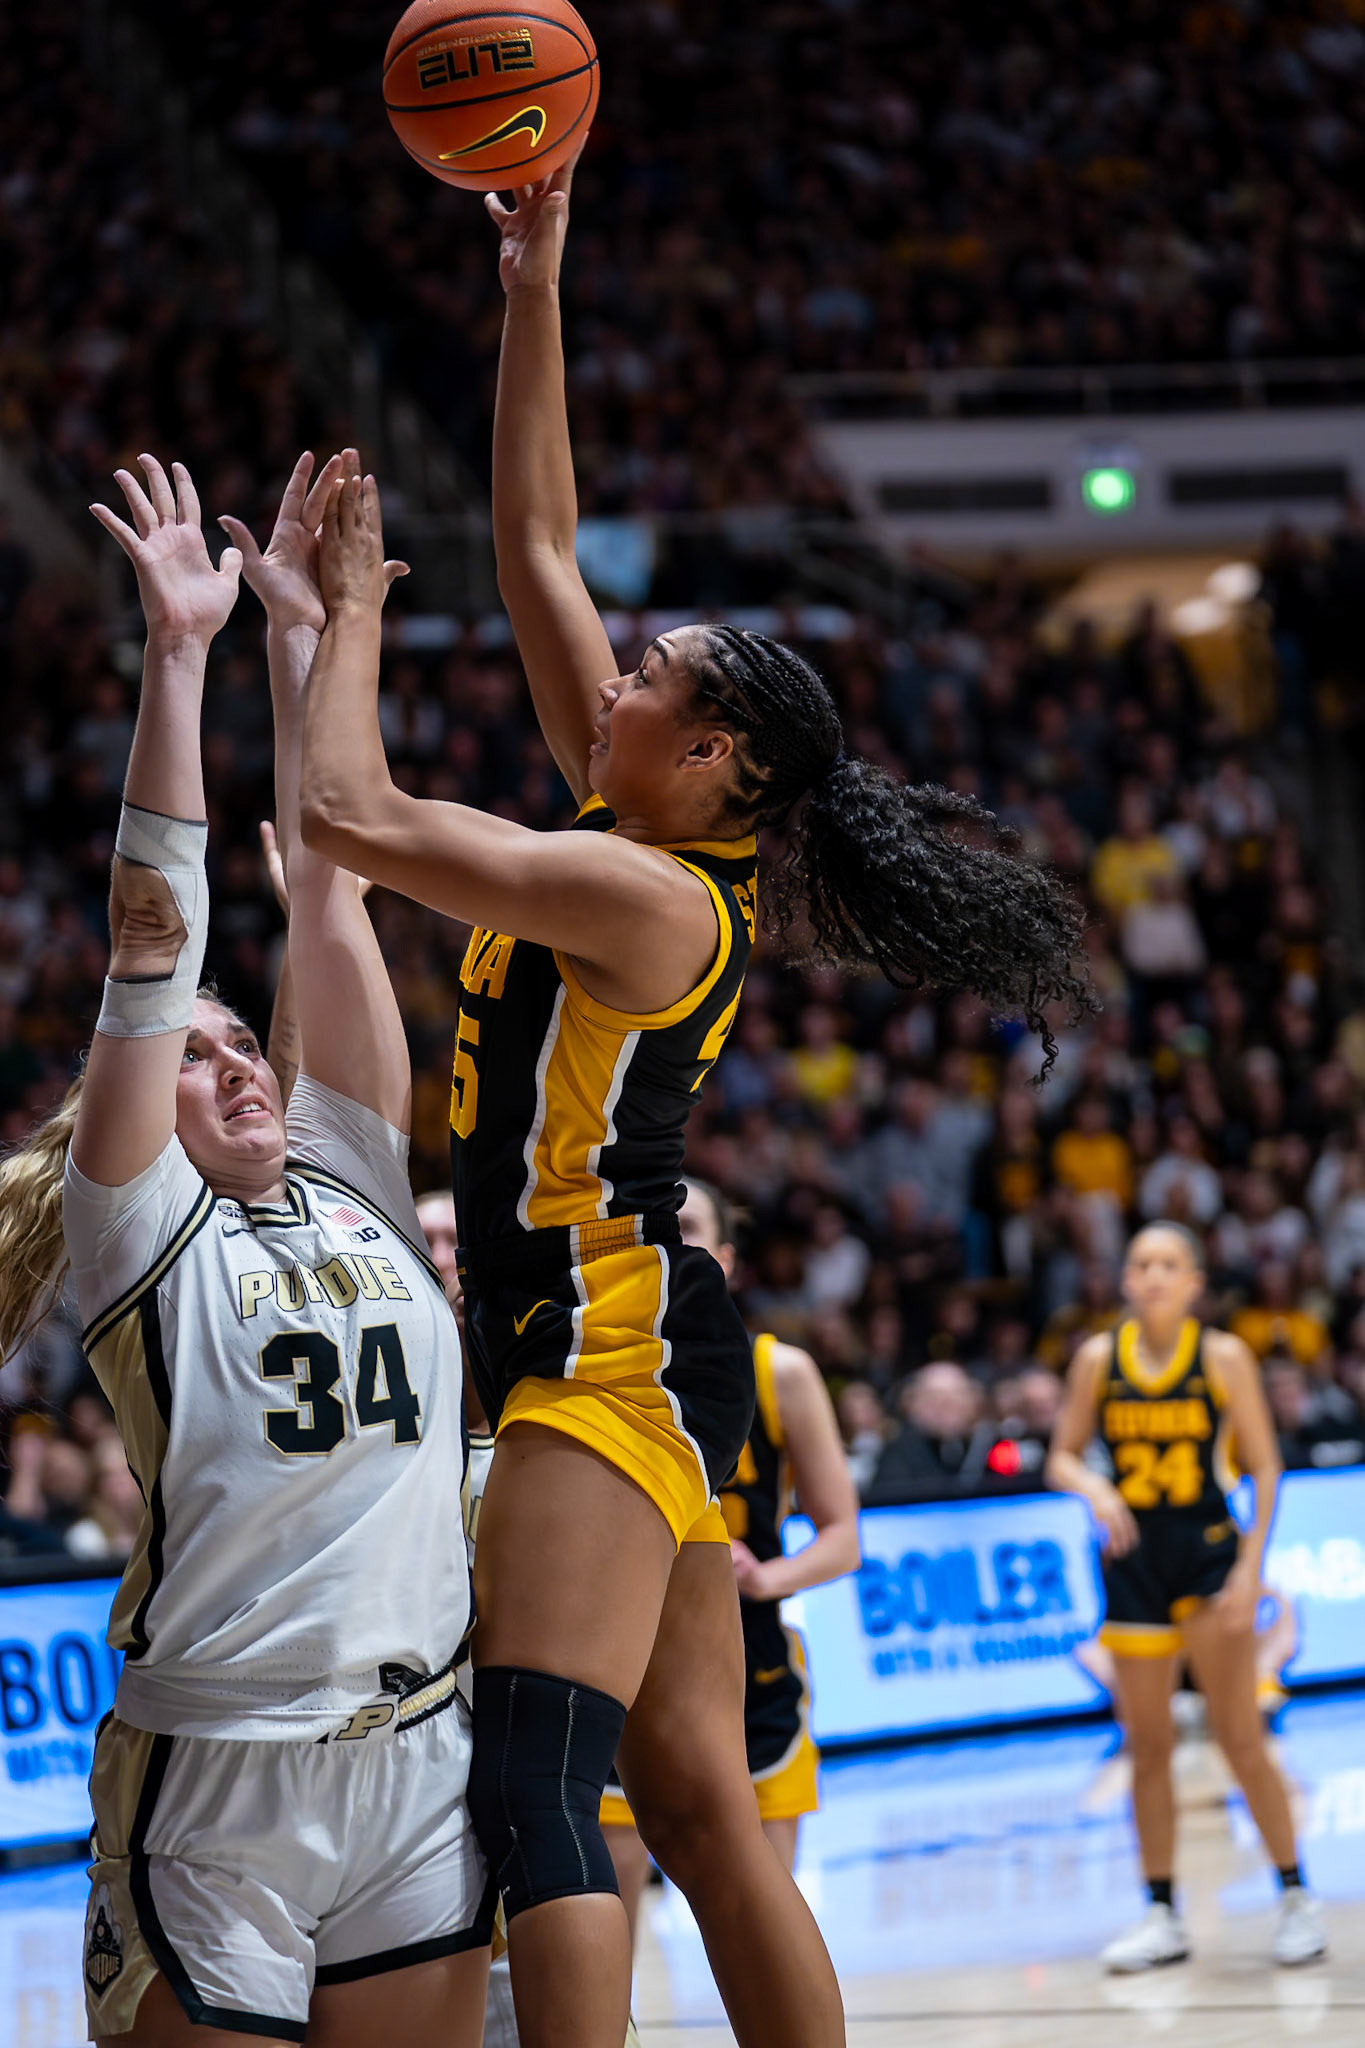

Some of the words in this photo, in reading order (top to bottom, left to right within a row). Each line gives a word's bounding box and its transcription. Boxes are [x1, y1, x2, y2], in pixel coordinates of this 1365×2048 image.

[418, 39, 535, 90] ELITE
[238, 1253, 413, 1320] PURDUE
[258, 1321, 422, 1457] 34
[1114, 1440, 1204, 1508] 24
[857, 1540, 1073, 1638] BOILER
[333, 1704, 395, 1741] P
